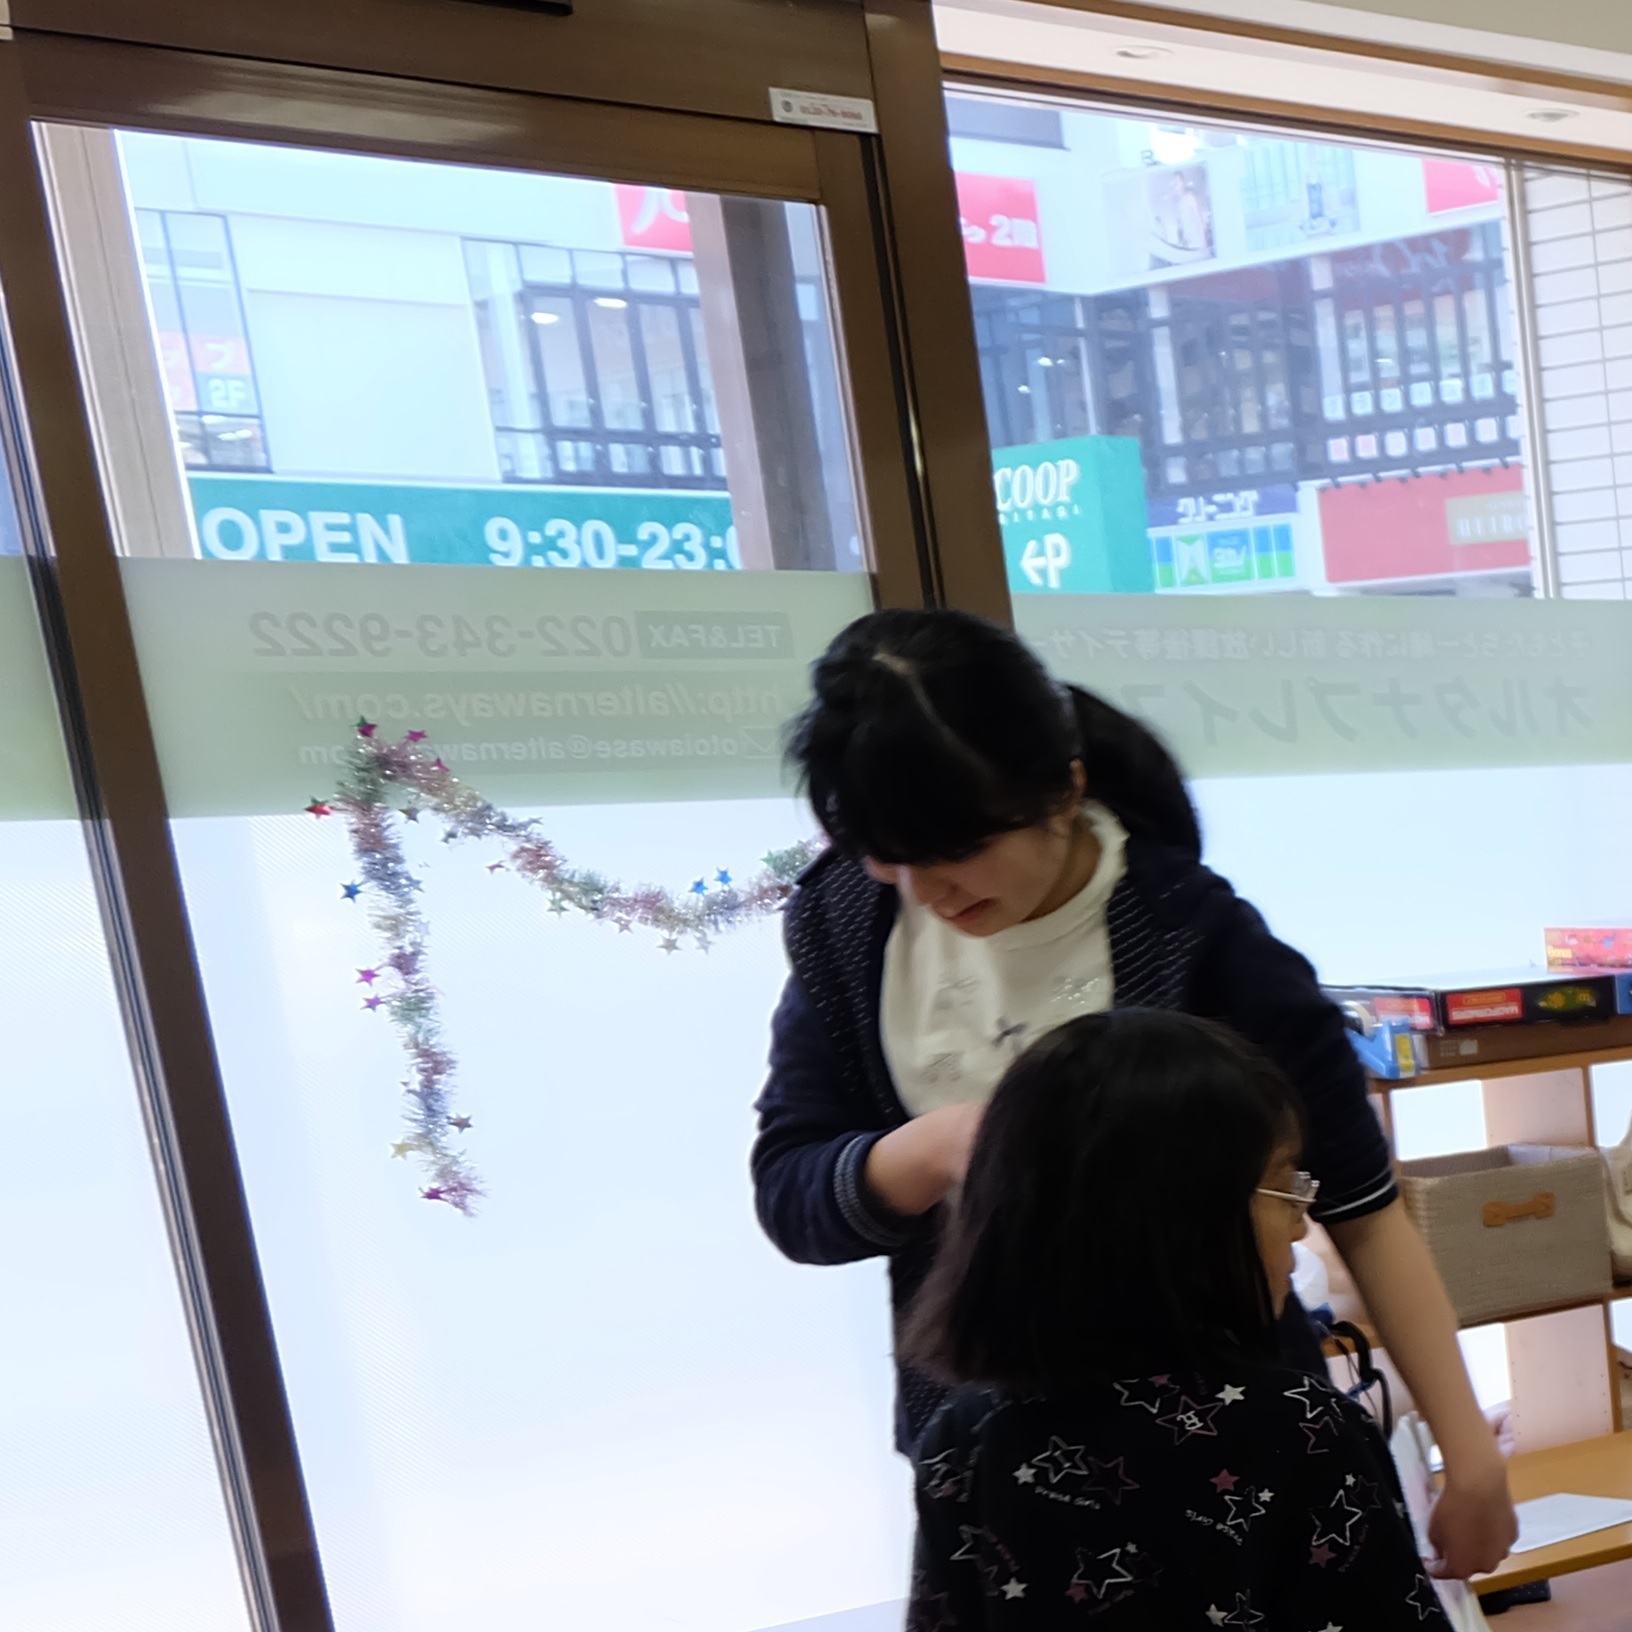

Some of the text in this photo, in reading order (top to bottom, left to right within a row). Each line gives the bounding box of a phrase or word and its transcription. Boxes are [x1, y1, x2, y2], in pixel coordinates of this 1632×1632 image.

[994, 459, 1080, 511] COOP
[201, 507, 410, 564] OPEN
[1043, 532, 1072, 588] P
